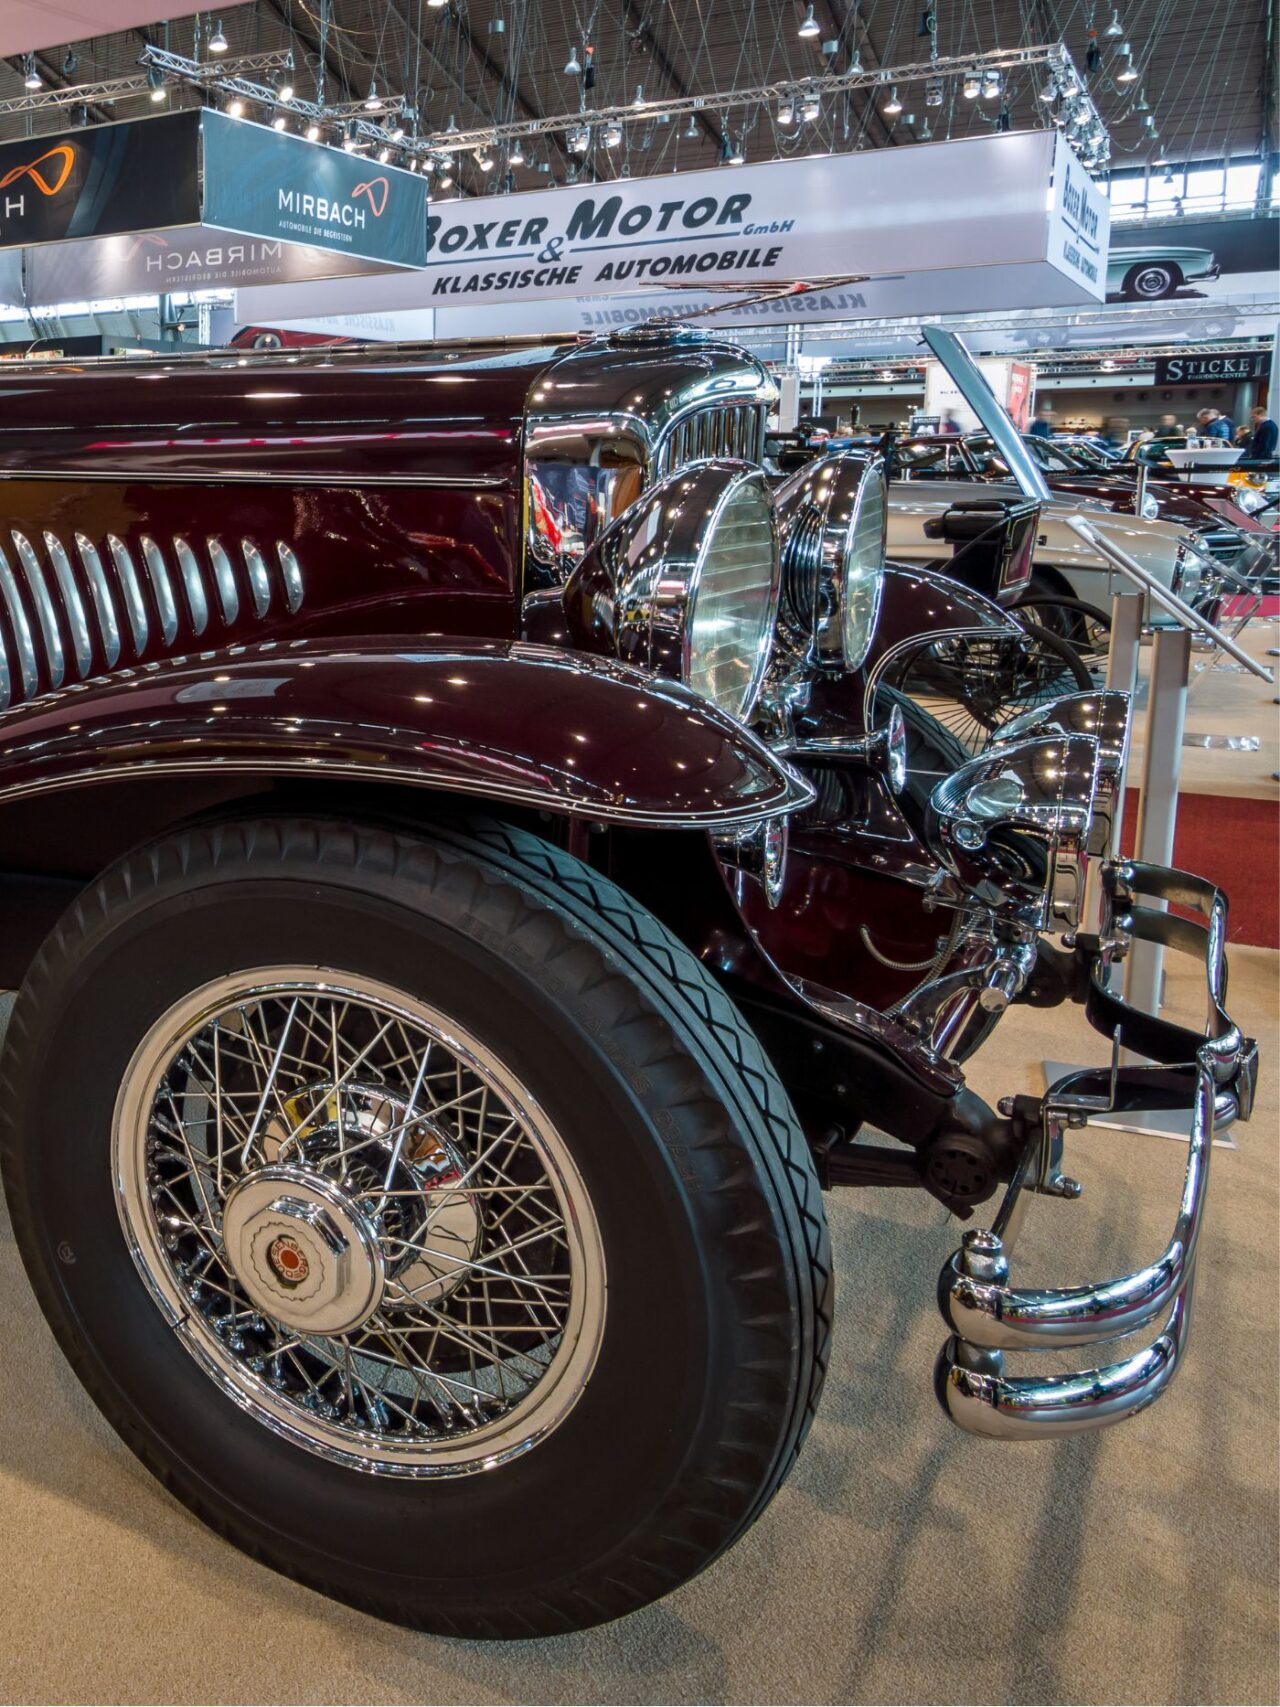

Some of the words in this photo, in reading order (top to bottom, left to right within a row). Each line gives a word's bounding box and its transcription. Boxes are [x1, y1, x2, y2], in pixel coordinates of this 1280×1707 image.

[278, 188, 366, 230] MIRBACH
[537, 236, 564, 264] &
[565, 193, 753, 241] MOTOR
[742, 219, 796, 236] GmbH
[278, 220, 312, 234] AUTOMOBILE
[313, 226, 322, 236] DIE
[323, 229, 353, 242] BEGEISTERN
[431, 265, 583, 296] KLASSISCHE
[593, 246, 784, 282] AUTOMOBILE
[1166, 355, 1270, 381] STICKEL
